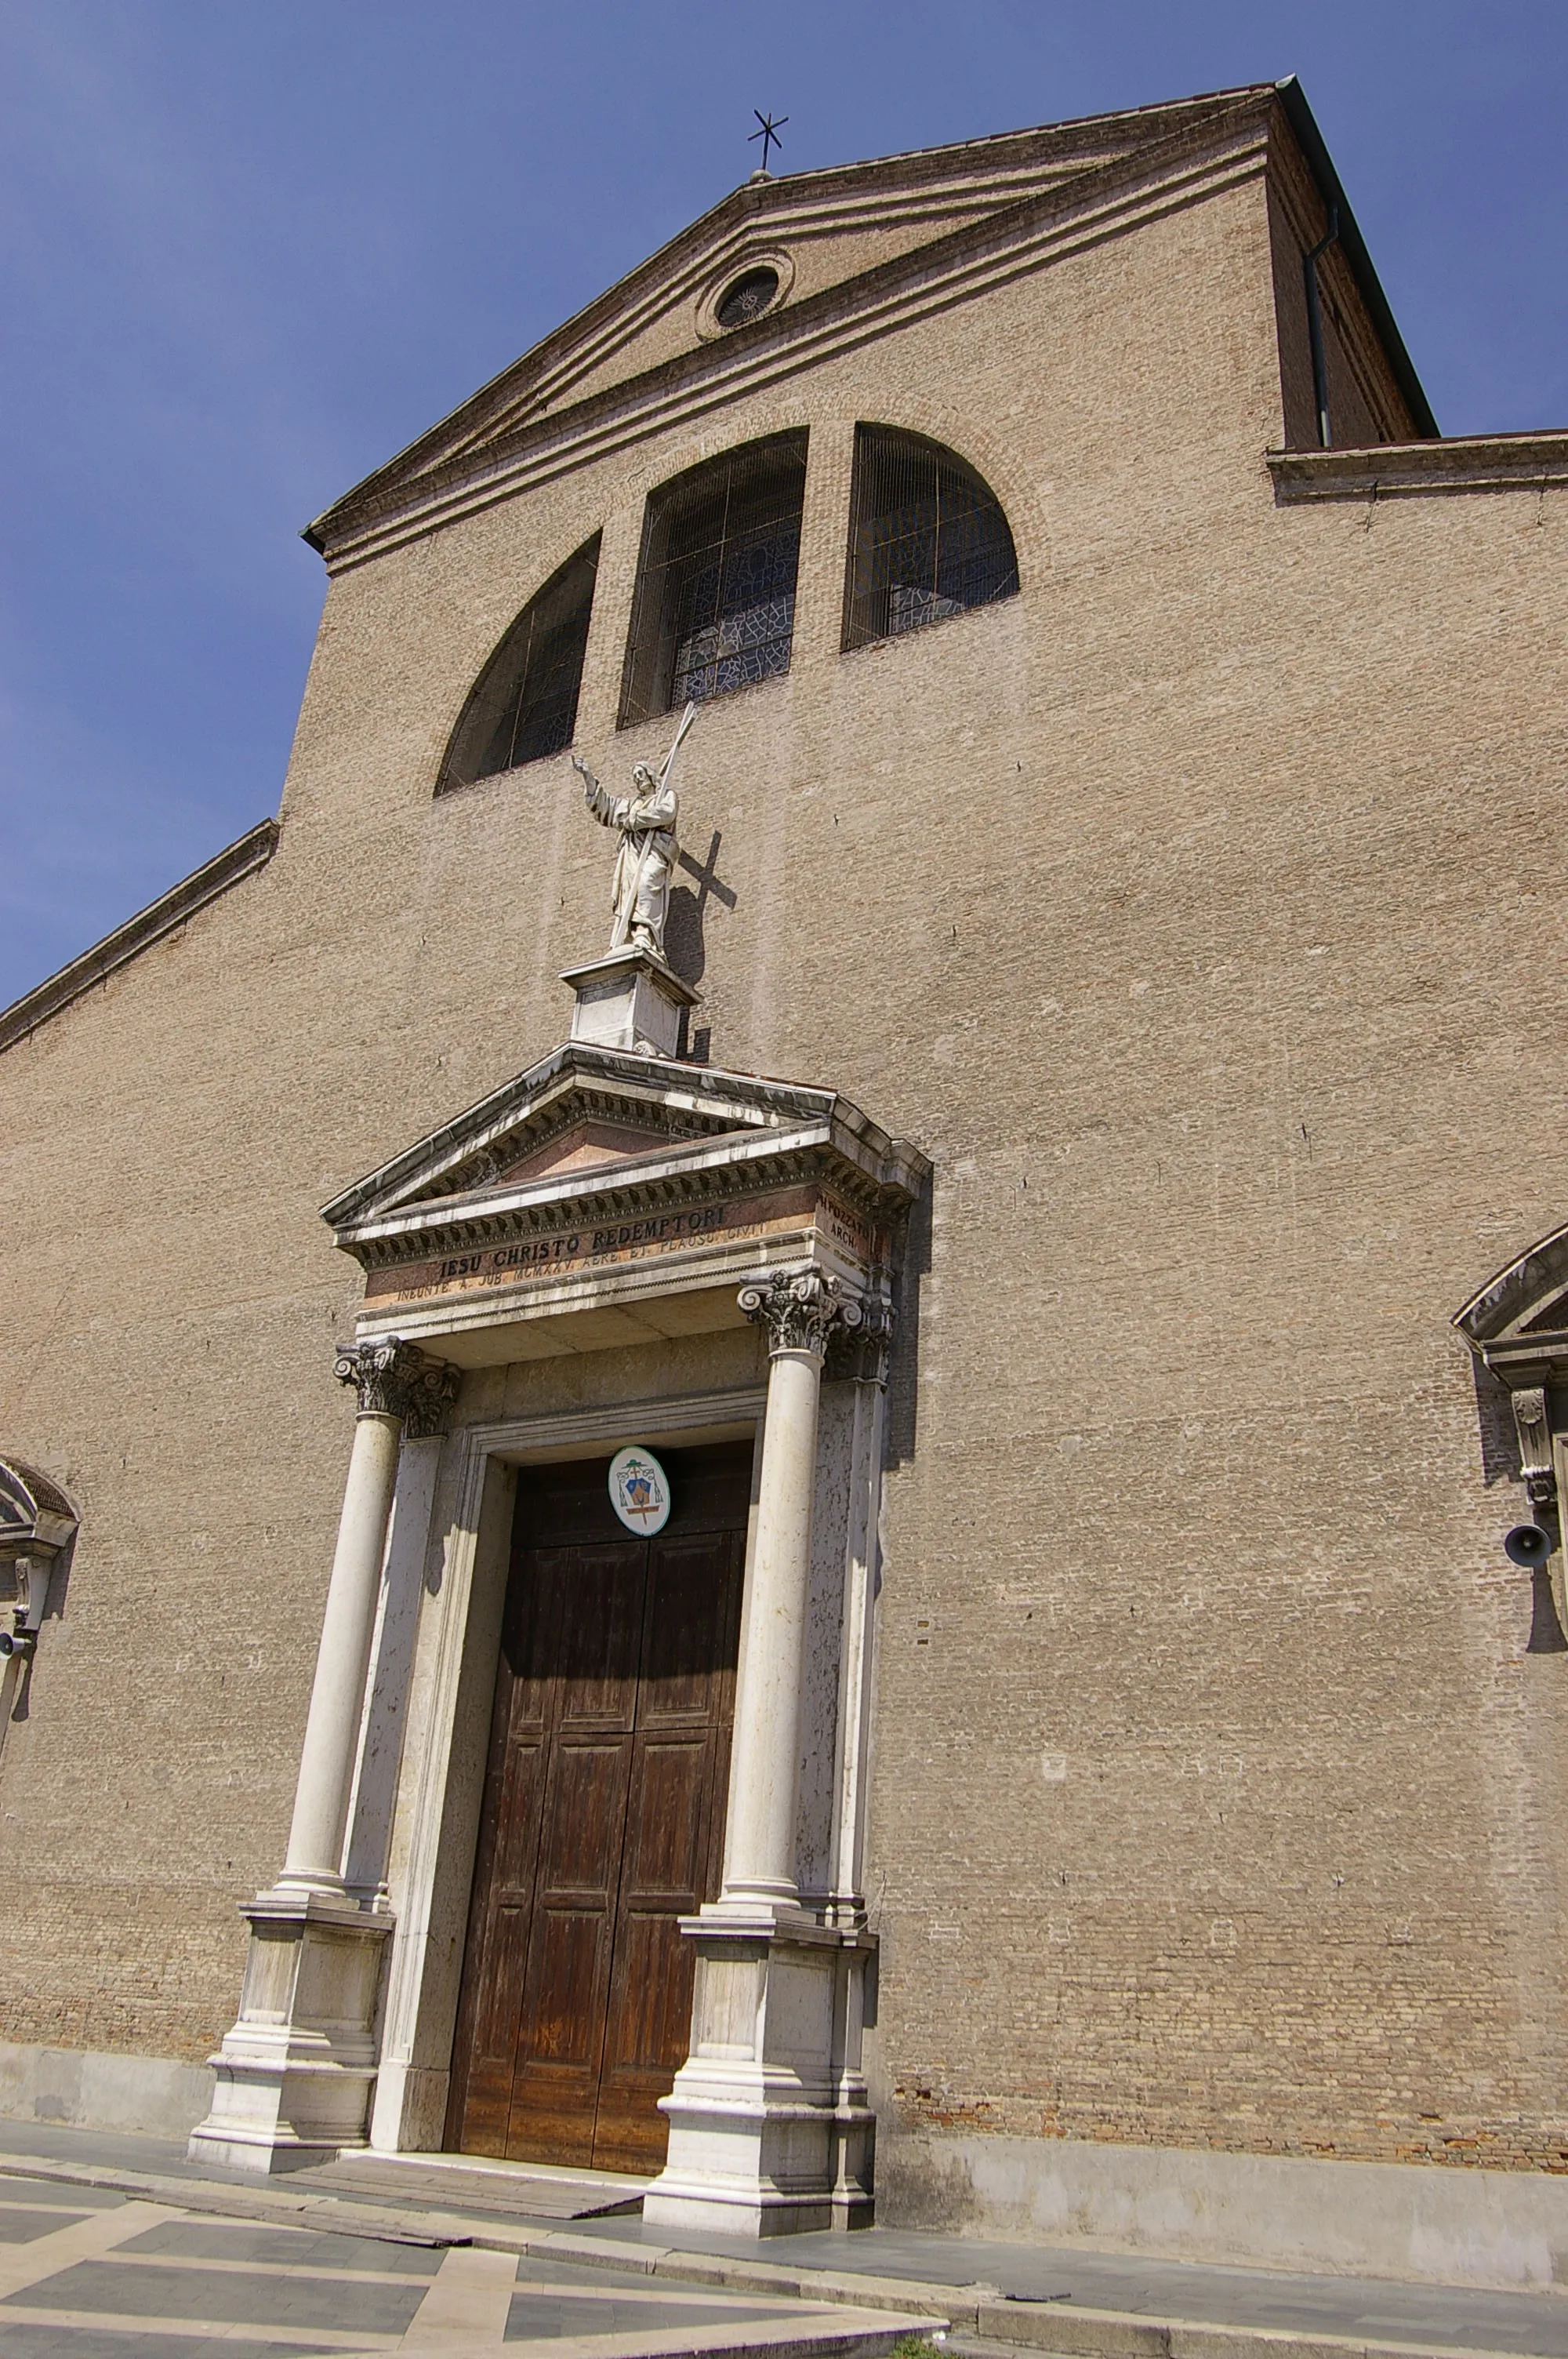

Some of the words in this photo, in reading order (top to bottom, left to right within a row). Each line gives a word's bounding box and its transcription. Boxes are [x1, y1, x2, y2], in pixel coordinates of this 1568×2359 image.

[440, 1255, 481, 1278] IESU
[494, 1237, 579, 1266] CHRISTO
[592, 1208, 724, 1249] REDEMPTORI
